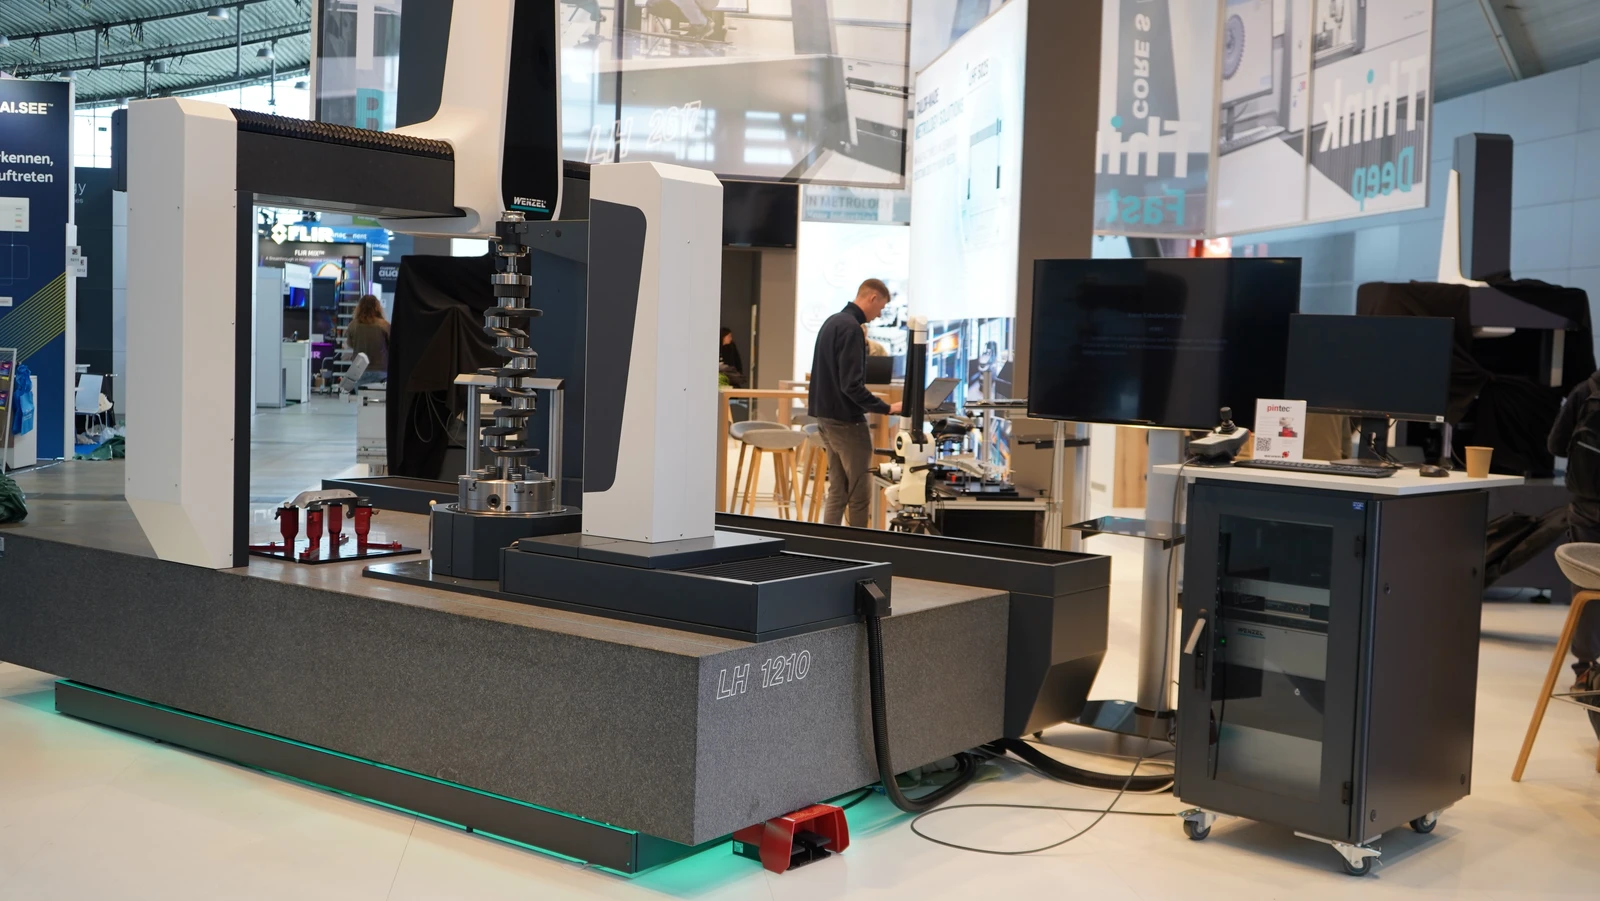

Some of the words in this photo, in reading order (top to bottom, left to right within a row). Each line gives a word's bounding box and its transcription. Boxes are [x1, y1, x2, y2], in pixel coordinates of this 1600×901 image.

[0, 151, 54, 167] kennen,
[513, 196, 547, 208] WENZEL
[288, 225, 334, 243] FLIR
[1266, 404, 1292, 412] pintec
[716, 663, 751, 700] LH
[761, 649, 811, 688] 1210
